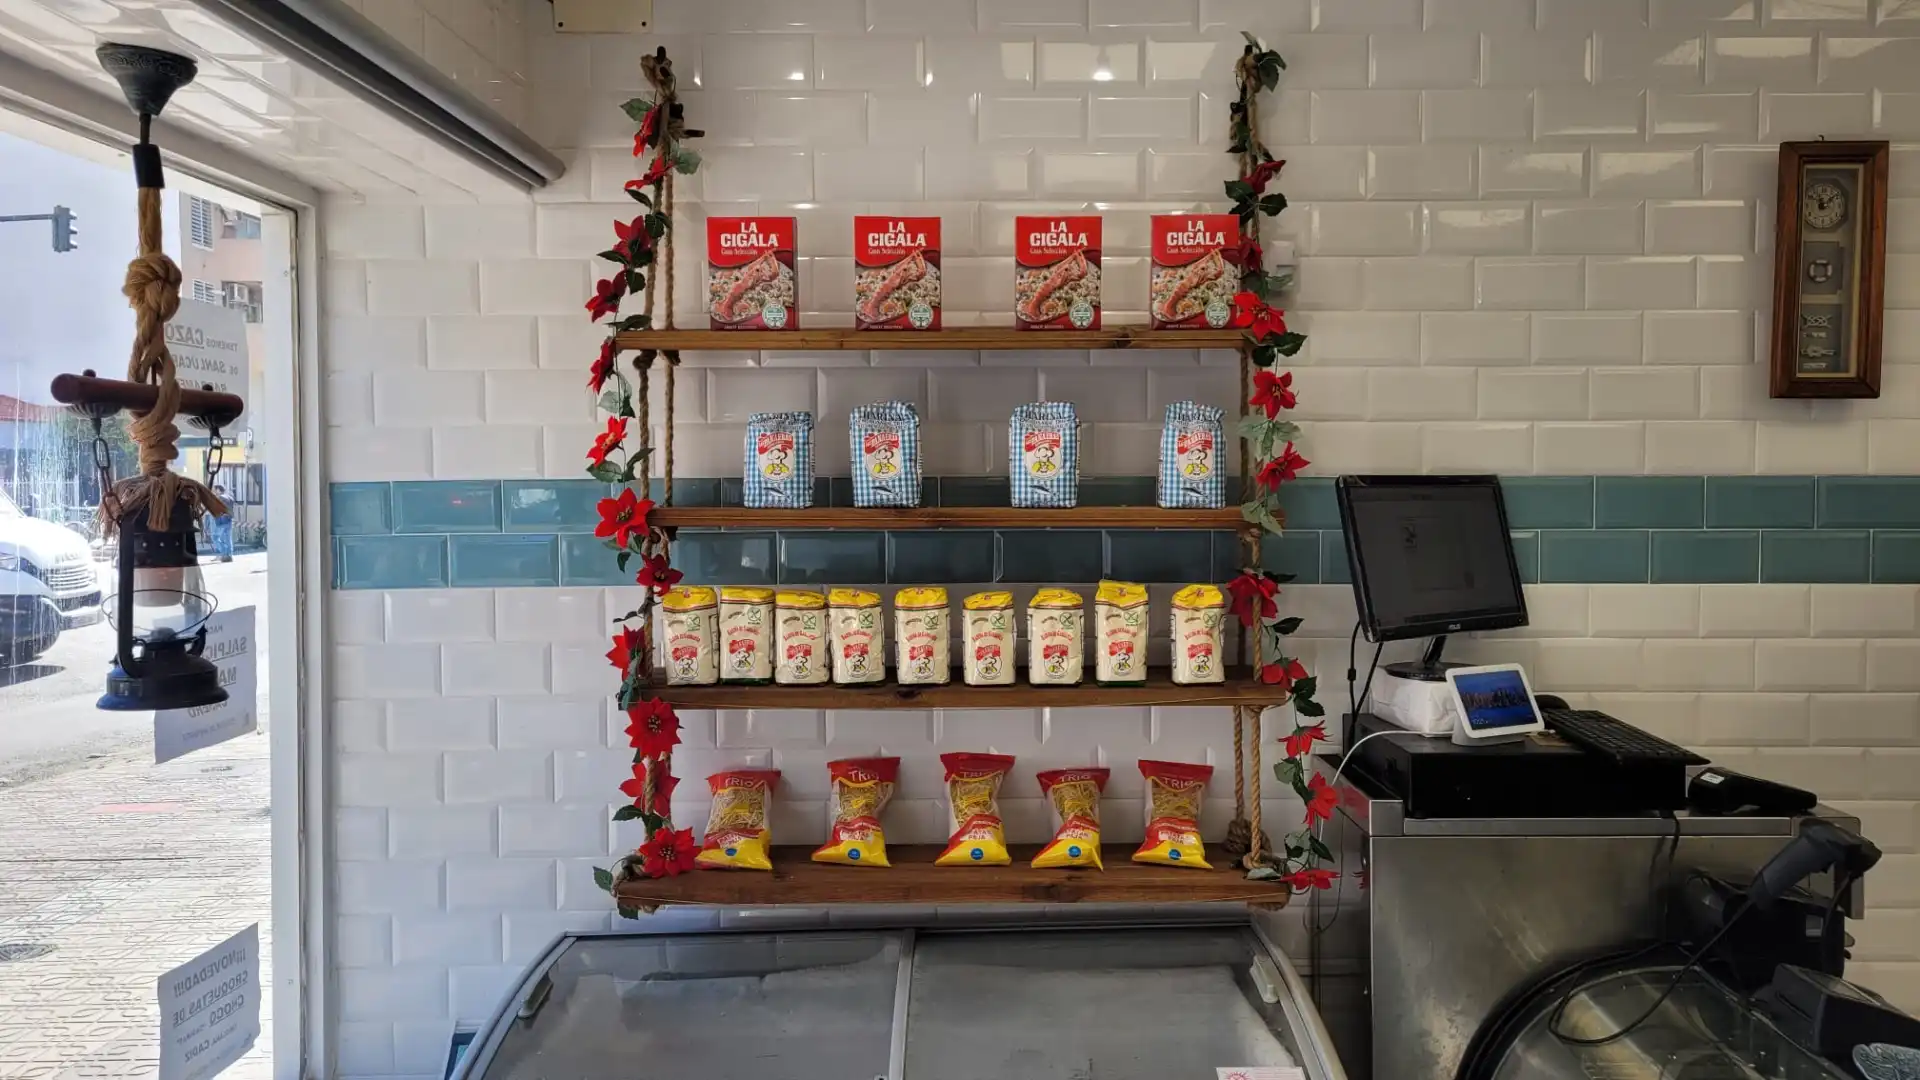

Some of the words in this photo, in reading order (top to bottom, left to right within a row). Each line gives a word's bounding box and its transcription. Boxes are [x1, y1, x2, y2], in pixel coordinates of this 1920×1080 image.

[741, 222, 758, 233] LA
[888, 221, 906, 233] LA
[1050, 221, 1067, 232] LA
[1188, 220, 1205, 231] LA
[720, 233, 779, 247] CIGALA
[868, 233, 927, 247] CIGALA
[1029, 233, 1088, 247] CIGALA
[1166, 232, 1226, 246] CIGALA
[725, 777, 754, 787] TRIO
[1059, 773, 1091, 782] TRIO
[1160, 776, 1194, 789] TRIO
